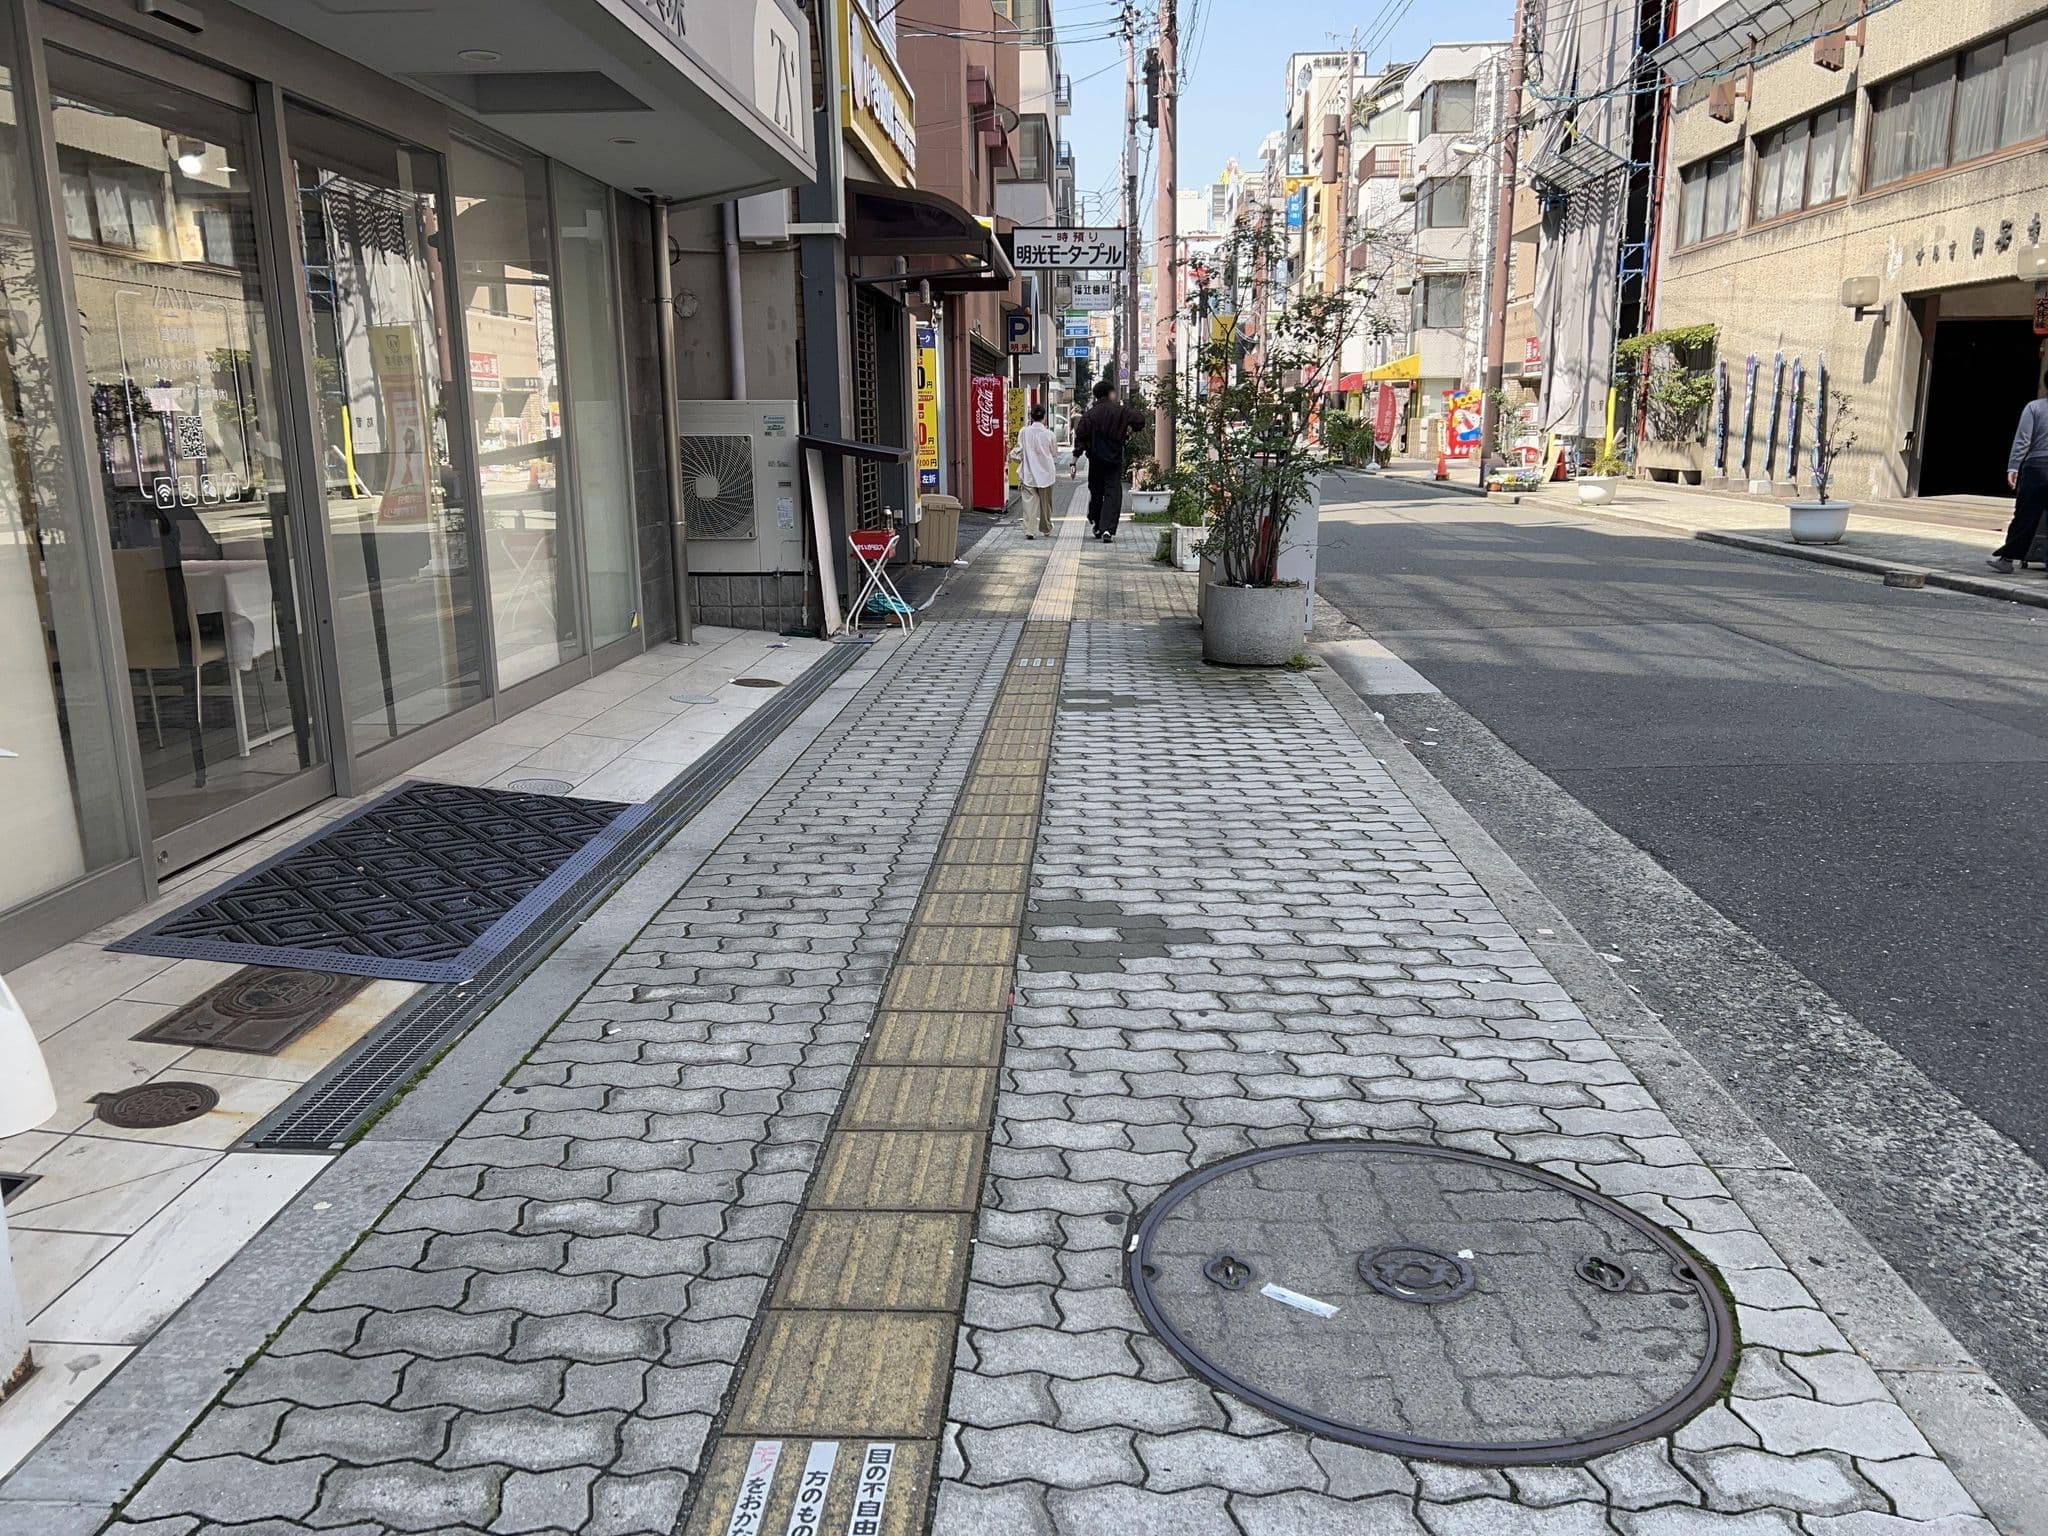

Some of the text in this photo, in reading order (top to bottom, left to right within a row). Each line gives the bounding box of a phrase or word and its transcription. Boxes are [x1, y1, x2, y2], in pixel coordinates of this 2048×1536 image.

[1041, 231, 1098, 243] 一時預り
[1016, 243, 1122, 264] 明光モータープール
[1010, 318, 1030, 342] P
[1010, 343, 1030, 352] 明光
